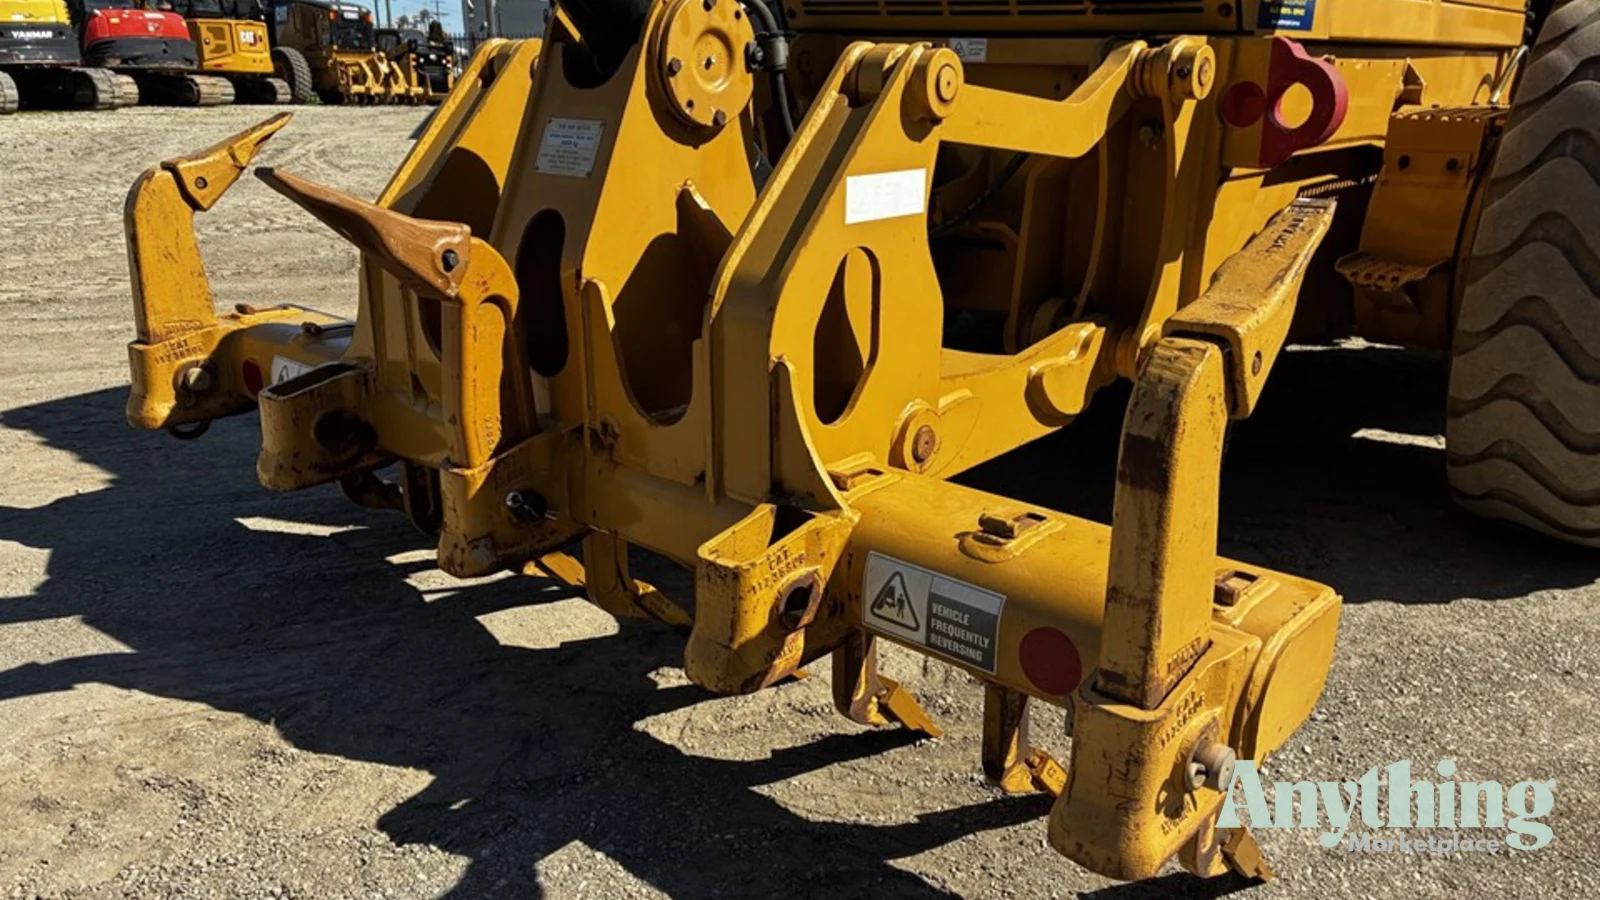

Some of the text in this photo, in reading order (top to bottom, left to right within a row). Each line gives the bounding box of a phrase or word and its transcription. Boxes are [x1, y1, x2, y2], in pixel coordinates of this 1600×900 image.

[11, 30, 53, 39] YANMAR
[240, 31, 254, 44] CAT
[769, 549, 788, 571] CAT
[932, 603, 970, 626] VEHICLE
[931, 620, 991, 649] FREQUENTLY
[929, 633, 983, 663] REVERSING
